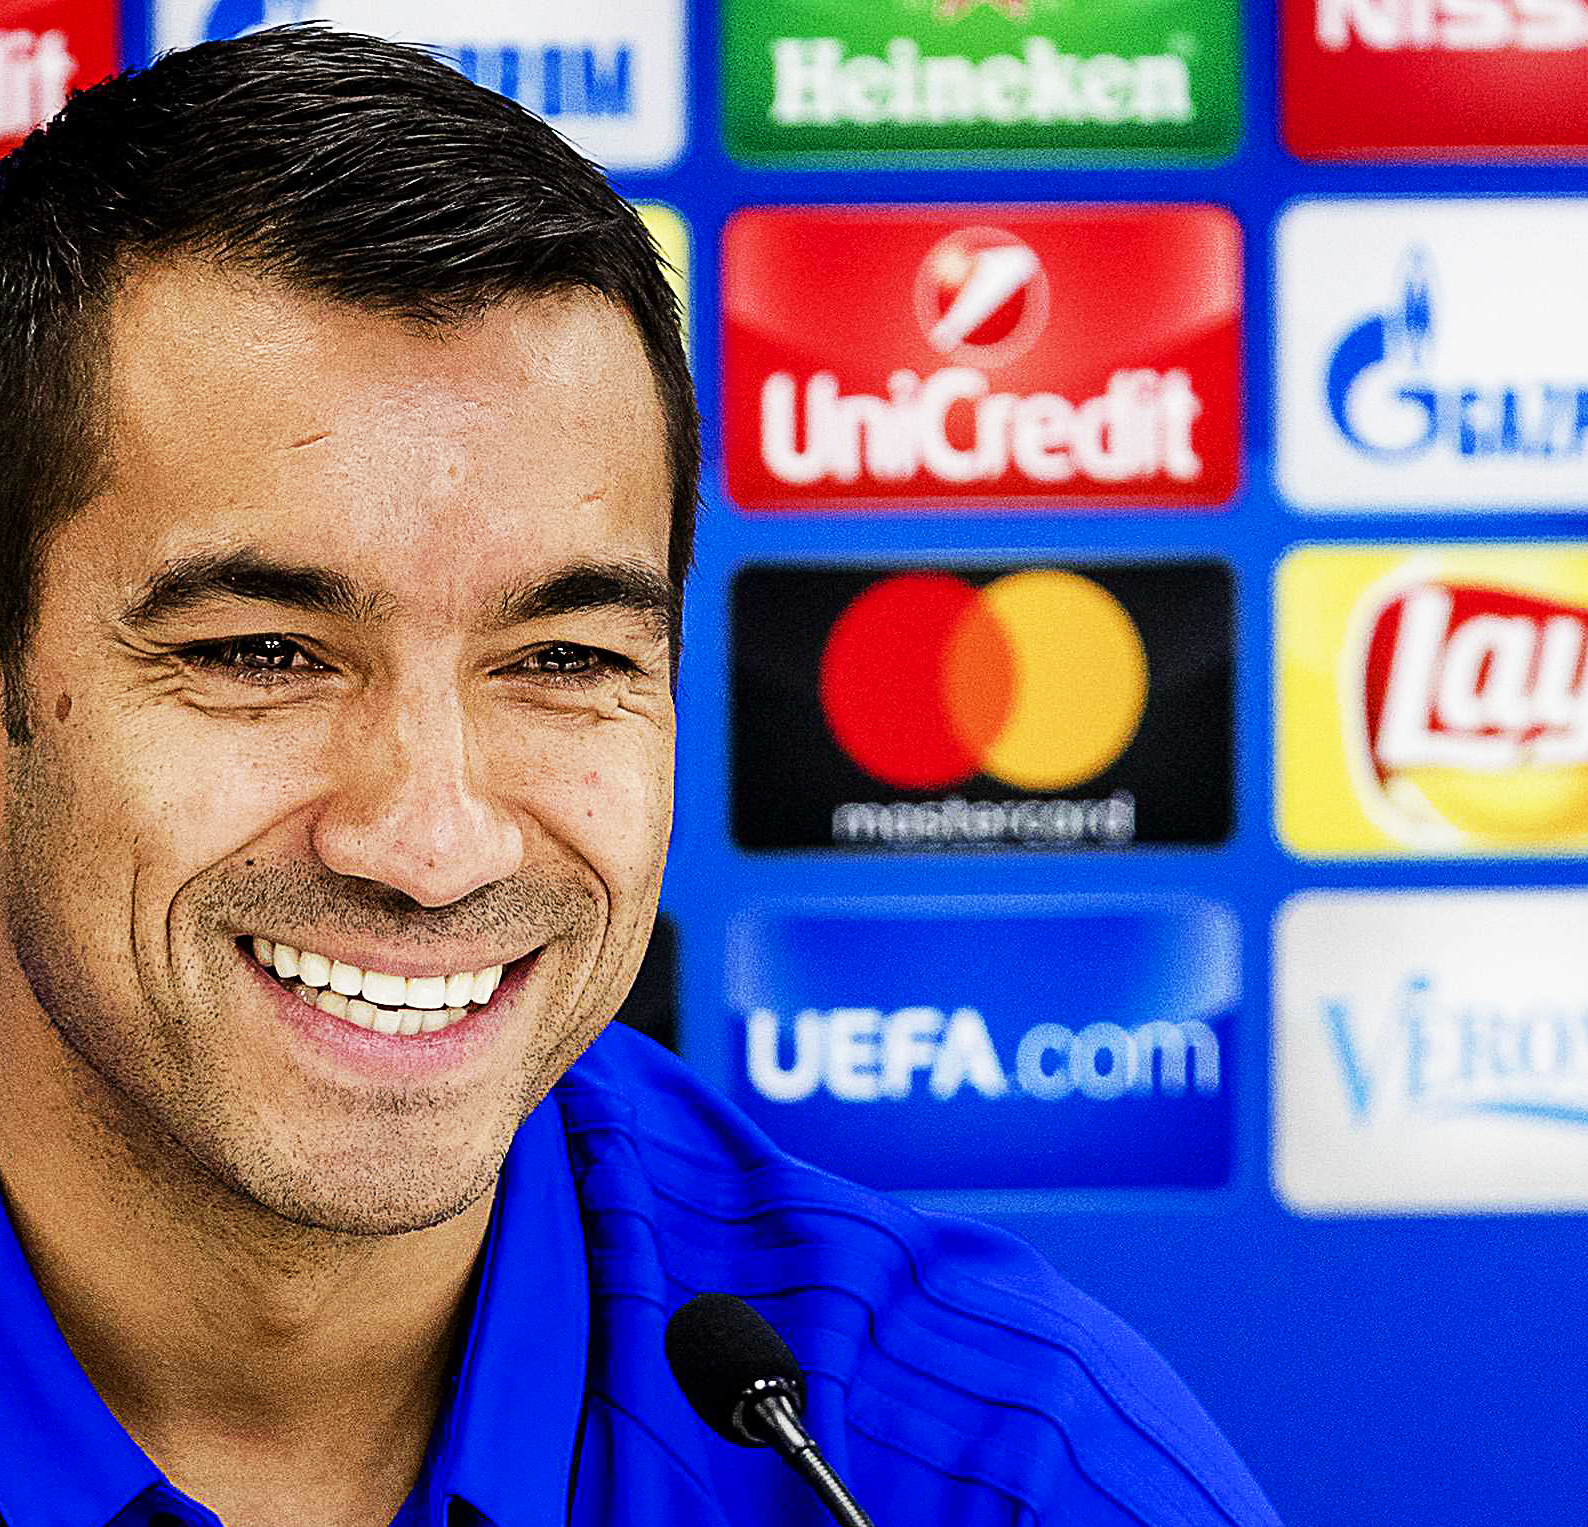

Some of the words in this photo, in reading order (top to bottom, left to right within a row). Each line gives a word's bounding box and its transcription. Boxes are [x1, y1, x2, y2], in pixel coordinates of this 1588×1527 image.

[771, 36, 1193, 123] Heineken
[760, 367, 1202, 484] UniCredit
[746, 1005, 1221, 1102] UEFA.com
